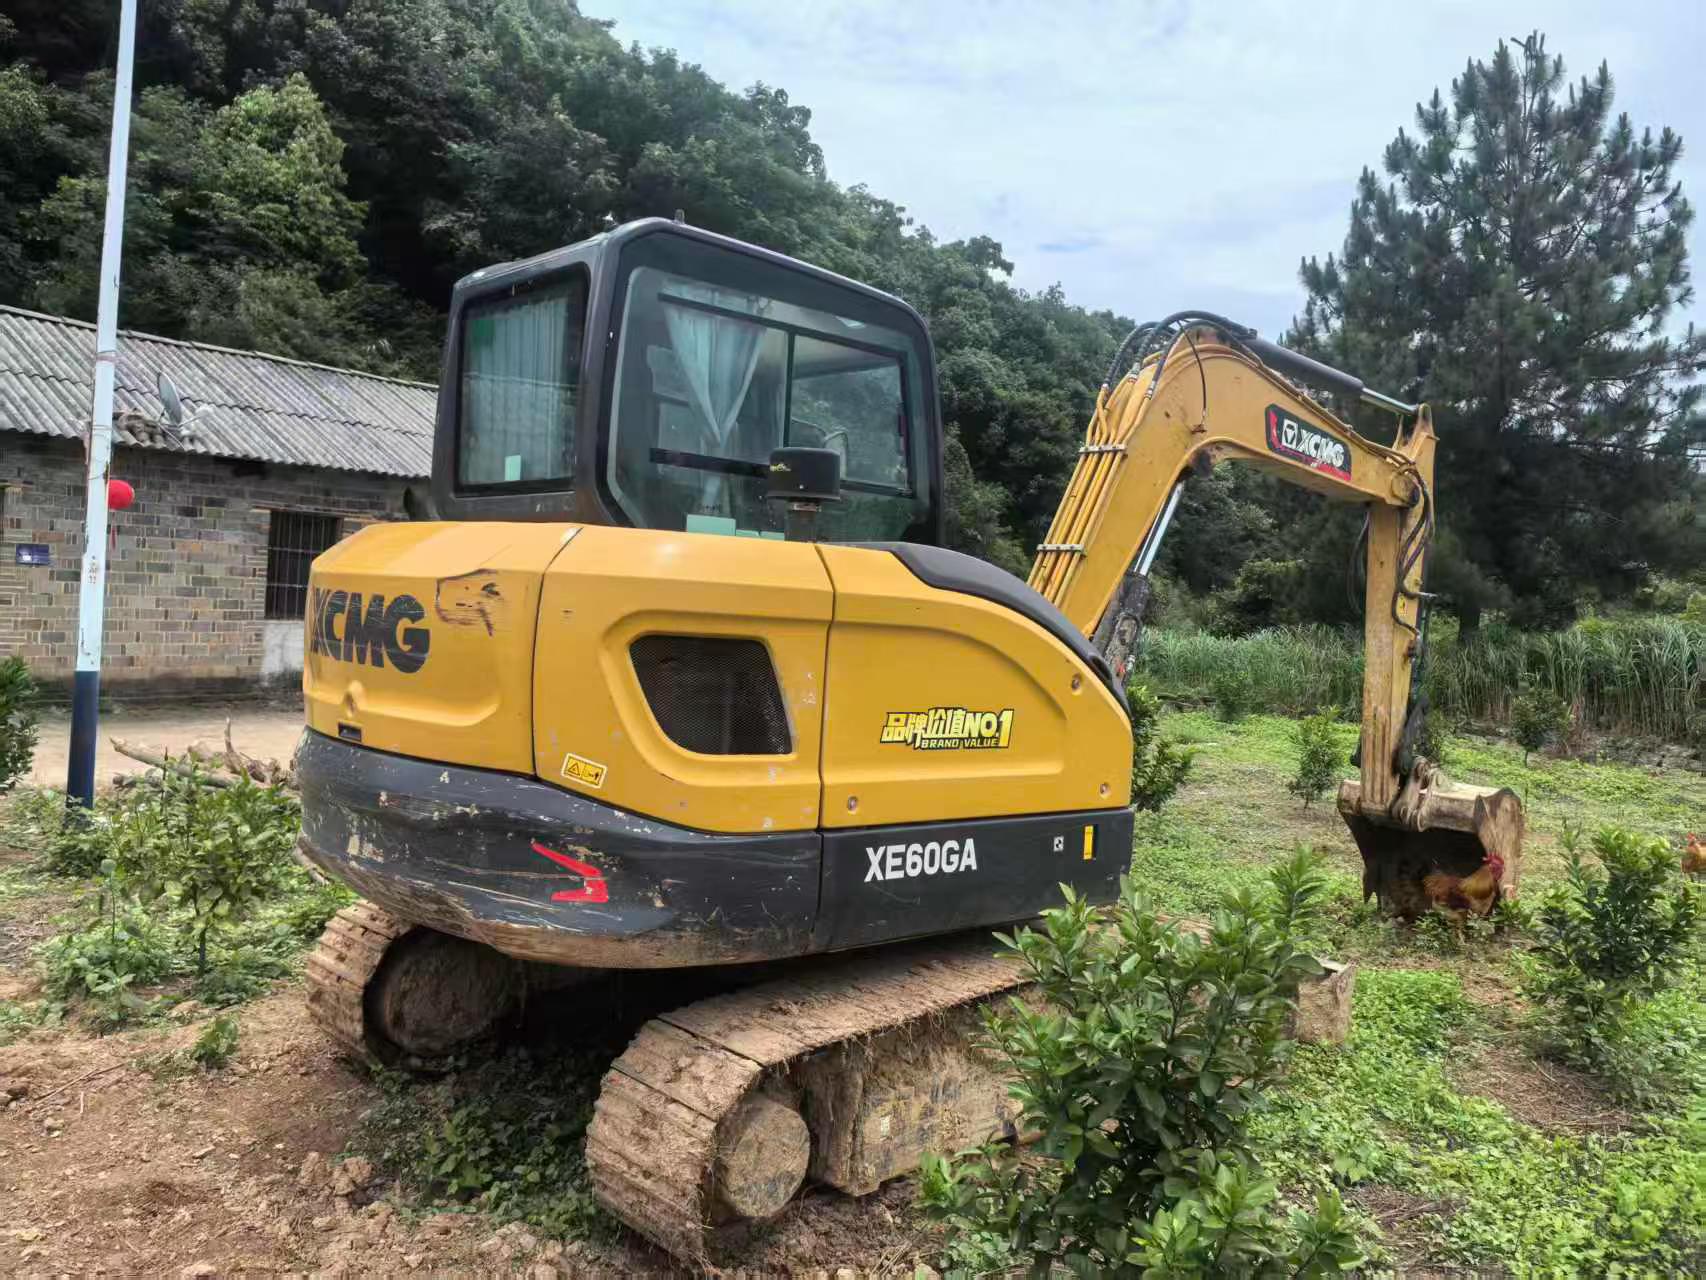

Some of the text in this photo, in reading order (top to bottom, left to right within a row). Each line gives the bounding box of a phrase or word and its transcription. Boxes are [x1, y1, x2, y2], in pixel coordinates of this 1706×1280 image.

[1297, 428, 1345, 468] XCMG
[310, 588, 431, 674] XCMG
[921, 737, 1000, 749] BRAND VALUE
[864, 838, 978, 882] XE60GA
